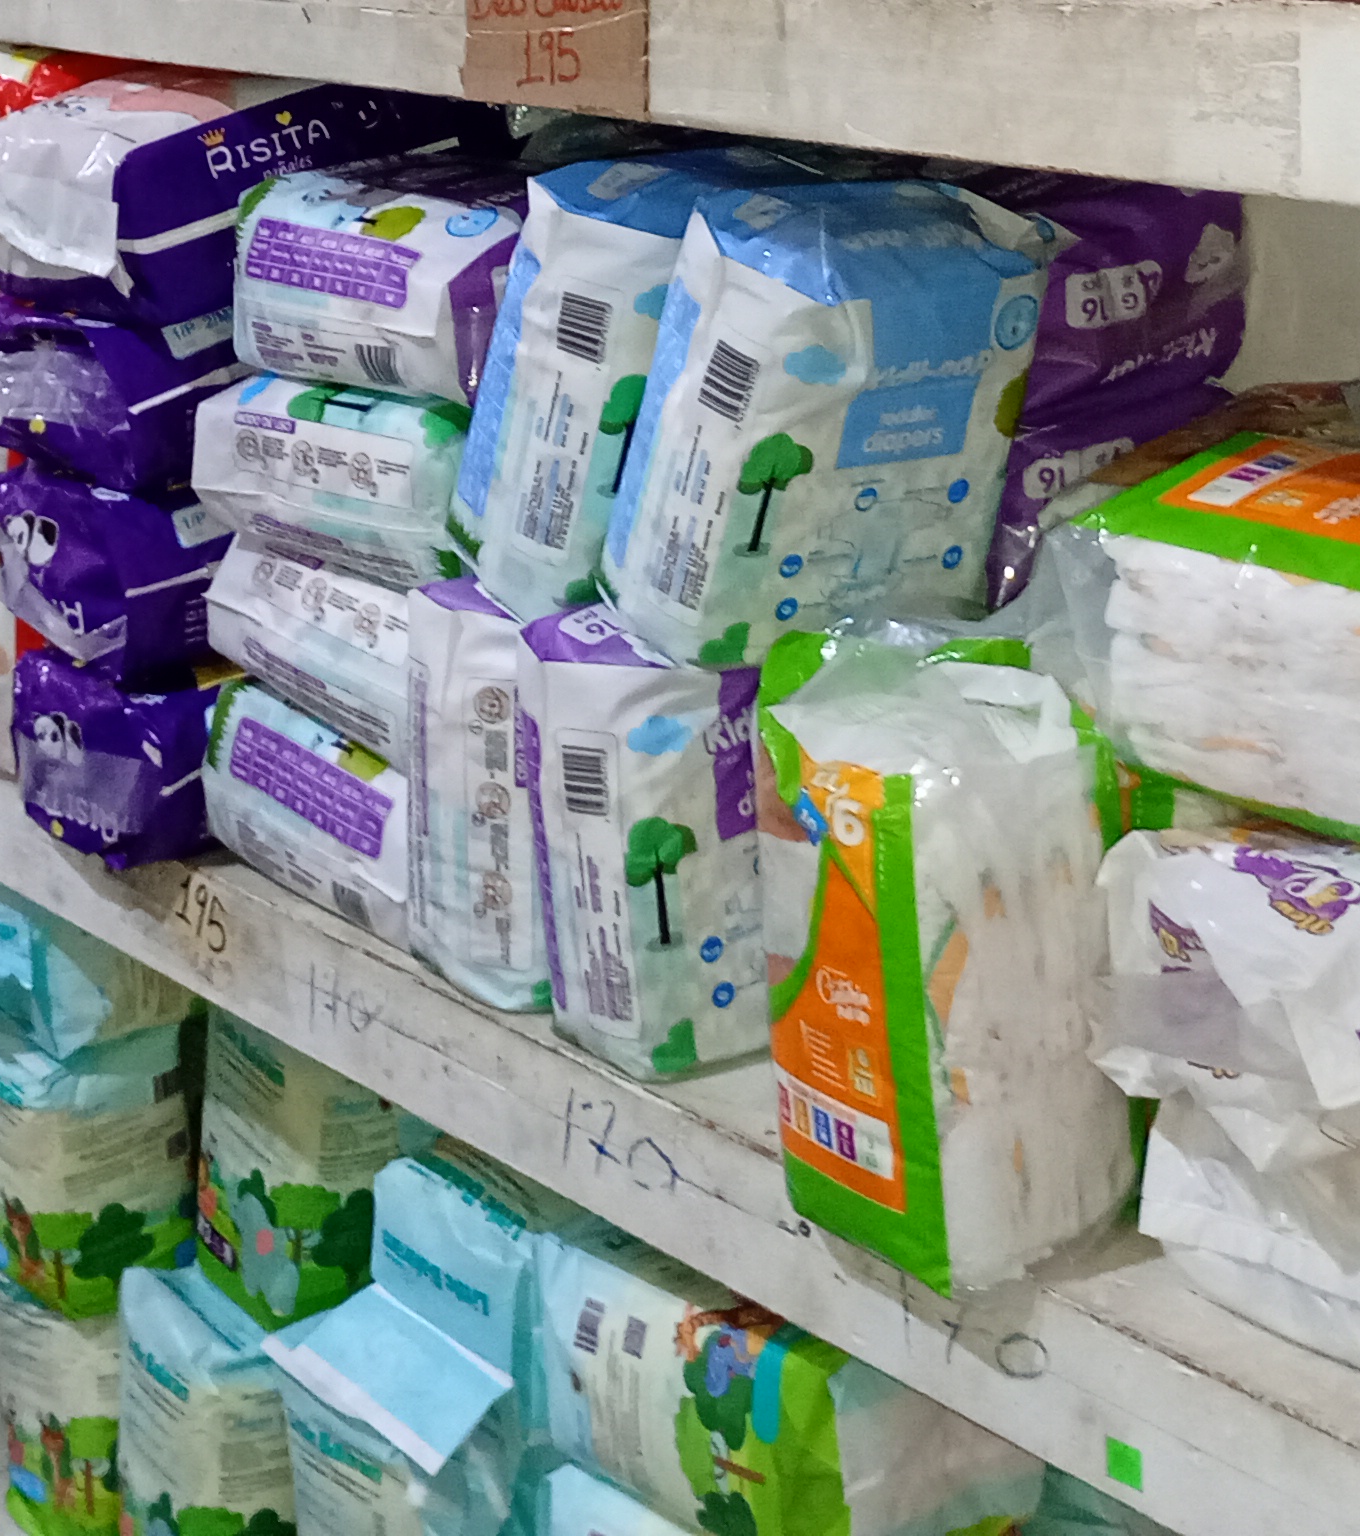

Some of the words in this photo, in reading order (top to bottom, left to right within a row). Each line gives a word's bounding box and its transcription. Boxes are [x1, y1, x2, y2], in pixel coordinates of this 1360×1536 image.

[516, 29, 581, 88] 195
[205, 118, 332, 180] RISITA
[175, 876, 228, 953] 195
